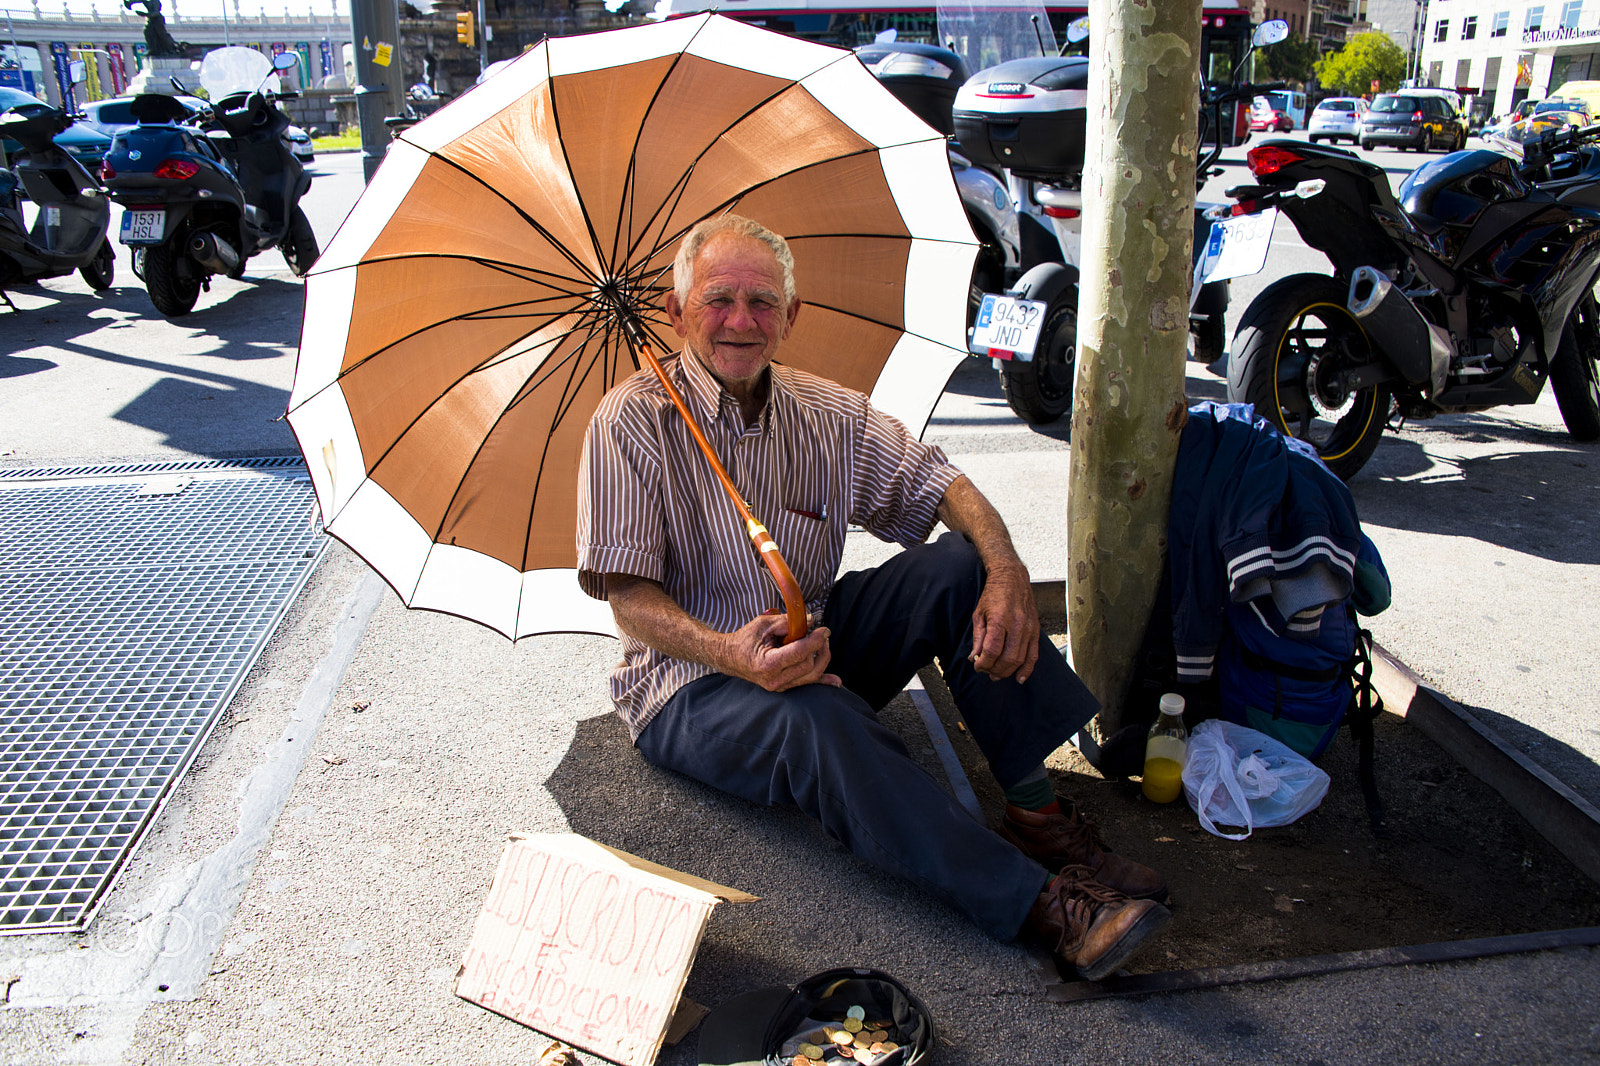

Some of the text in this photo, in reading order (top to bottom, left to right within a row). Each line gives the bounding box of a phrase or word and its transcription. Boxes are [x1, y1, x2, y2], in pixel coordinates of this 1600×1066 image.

[1522, 27, 1579, 43] CATALONIA
[134, 213, 161, 225] 1531
[132, 226, 155, 238] HSL
[995, 303, 1039, 326] 9432
[989, 326, 1022, 347] JND
[534, 942, 572, 975] ES
[480, 990, 602, 1042] AMALE
